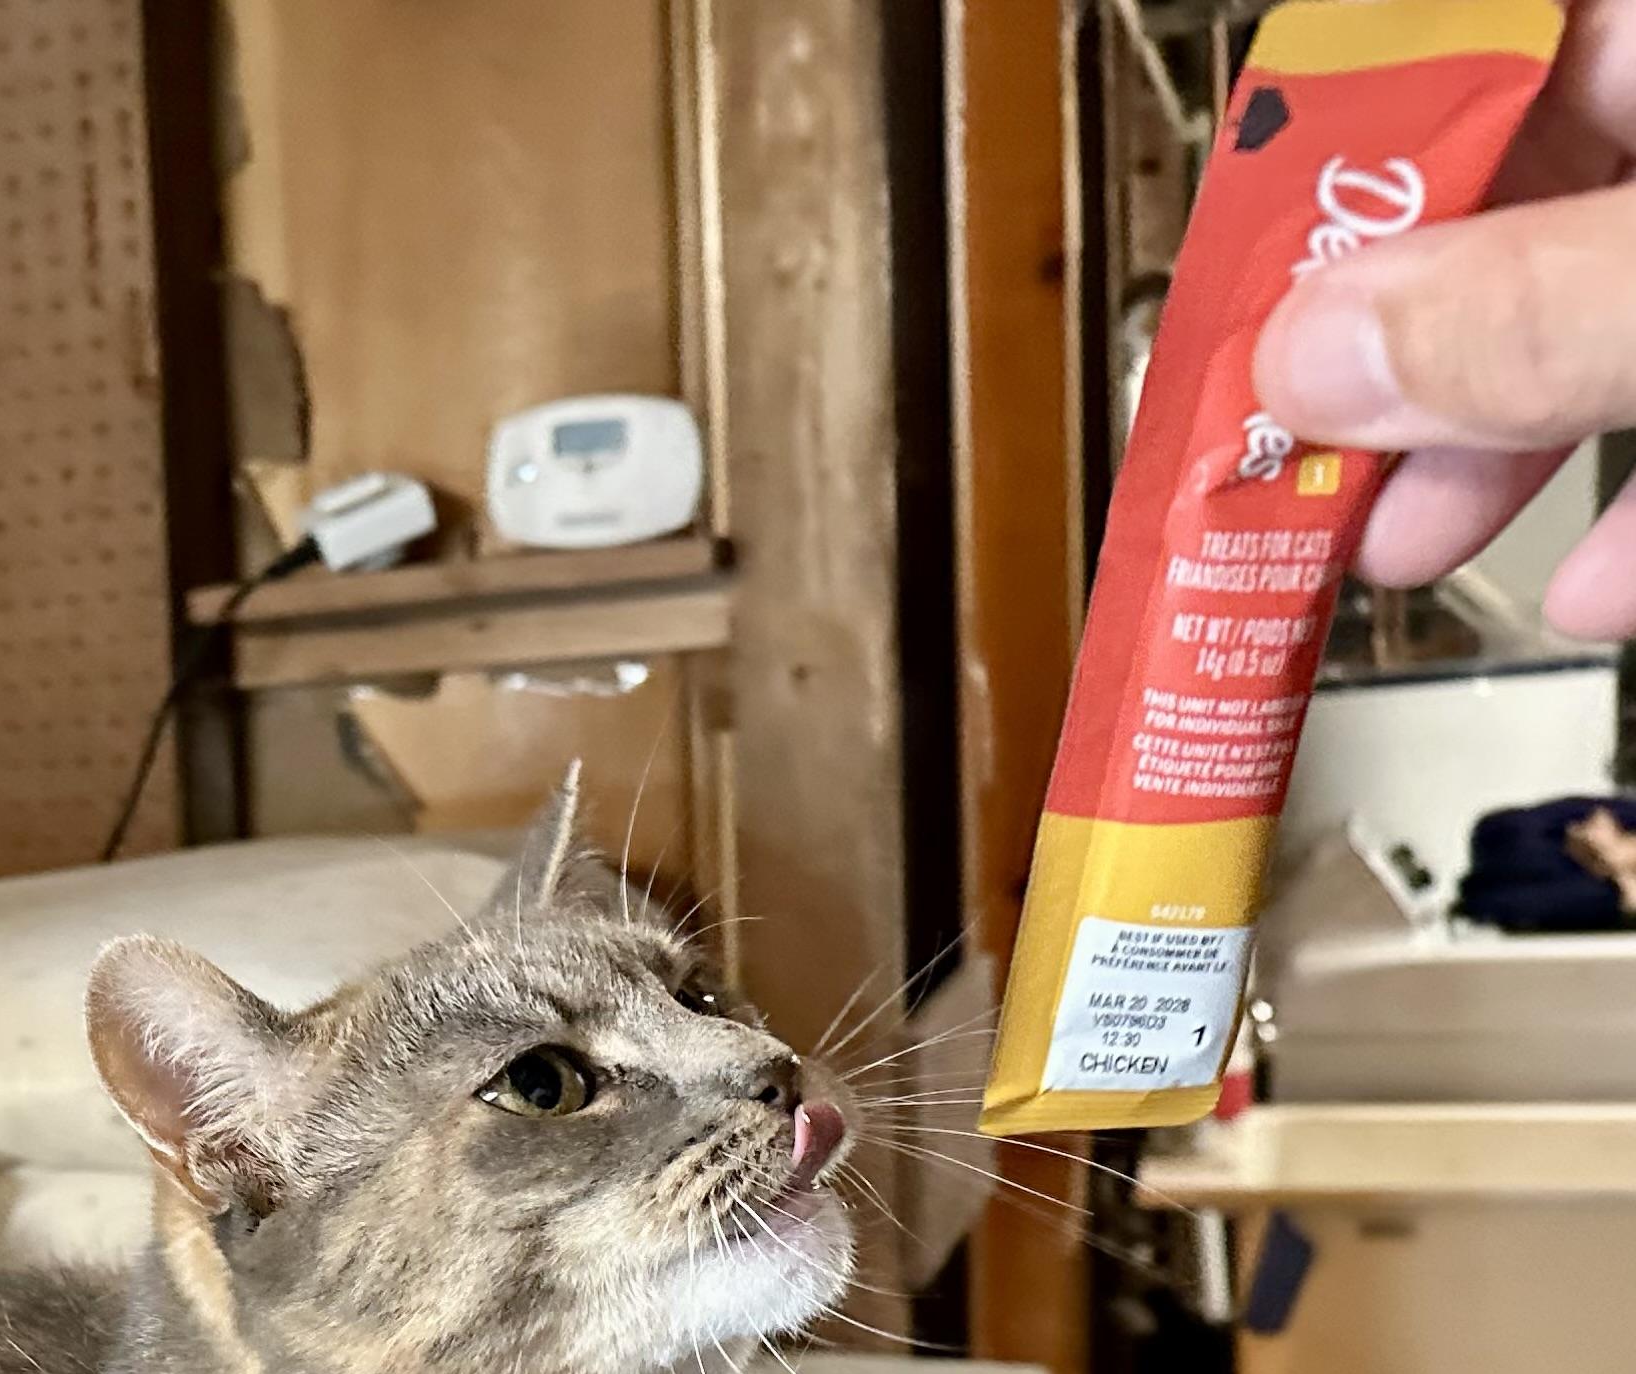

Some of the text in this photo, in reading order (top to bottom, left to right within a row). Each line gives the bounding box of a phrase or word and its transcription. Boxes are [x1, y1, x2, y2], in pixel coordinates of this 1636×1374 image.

[1201, 530, 1334, 560] TREATS FOR CATS
[1166, 555, 1258, 592] FRIANDISES
[1259, 563, 1303, 592] POUR
[1172, 612, 1205, 643] NET
[1205, 614, 1234, 645] WT
[1241, 617, 1292, 646] POIDS
[1143, 687, 1177, 709] THIS
[1178, 695, 1216, 713] UNIT
[1218, 697, 1251, 715] NOT
[1144, 710, 1177, 729] FOR
[1177, 716, 1264, 735] INDIVIDUAL
[1132, 732, 1181, 753] CETTE
[1213, 760, 1256, 778] POUR
[1133, 773, 1183, 796] VENTE
[1118, 930, 1149, 943] BEST
[1151, 932, 1165, 944] IF
[1166, 933, 1200, 946] USED
[1122, 944, 1202, 960] CONSOMMER
[1171, 961, 1212, 974] AVANT
[1088, 992, 1192, 1014] MAR 20 2028
[1192, 1024, 1207, 1047] 1
[1079, 1051, 1170, 1075] CHICKEN
